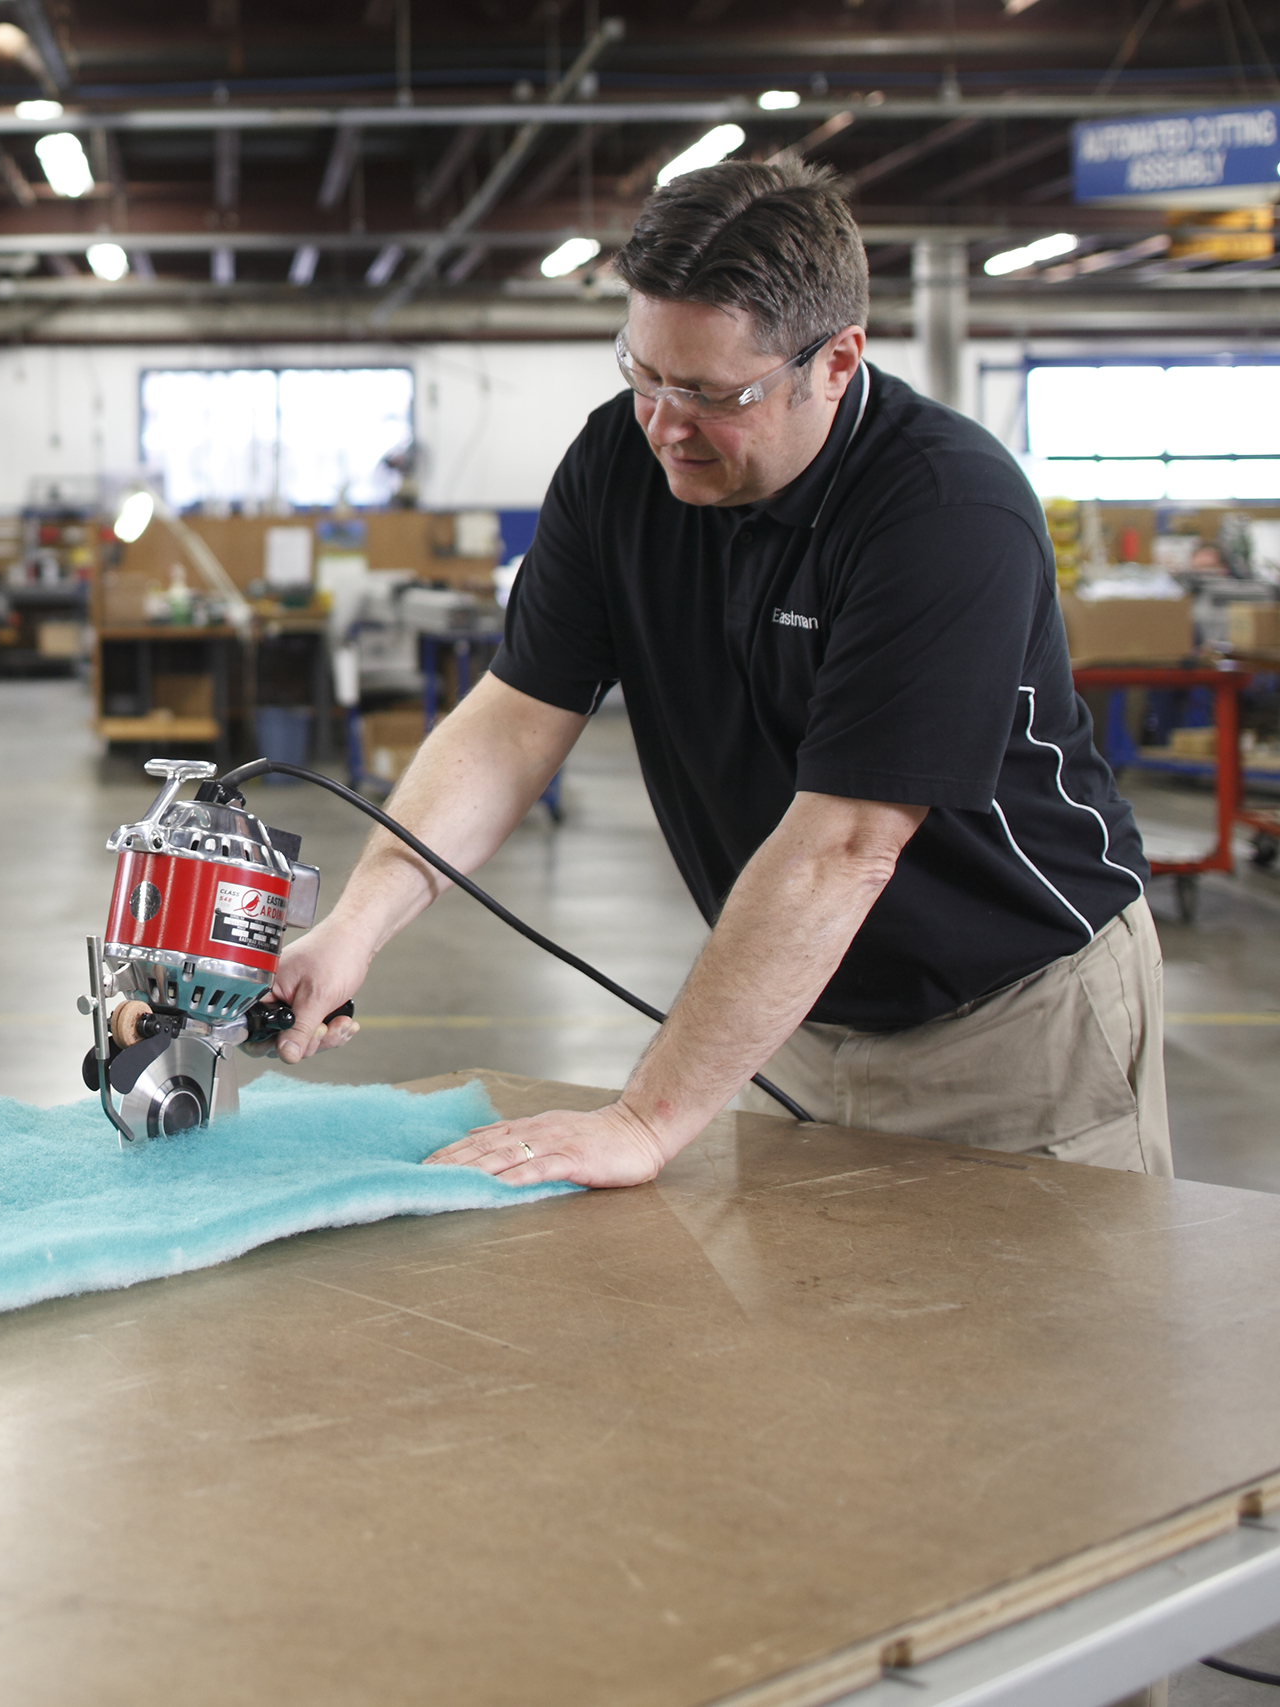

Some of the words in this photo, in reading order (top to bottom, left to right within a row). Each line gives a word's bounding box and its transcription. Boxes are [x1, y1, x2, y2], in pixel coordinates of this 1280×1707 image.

[1078, 118, 1193, 163] AUTOMATED
[1194, 110, 1276, 148] CUTTING
[1127, 149, 1227, 189] ASSEMBLY
[772, 607, 819, 629] Eastman
[220, 888, 240, 897] CLASS
